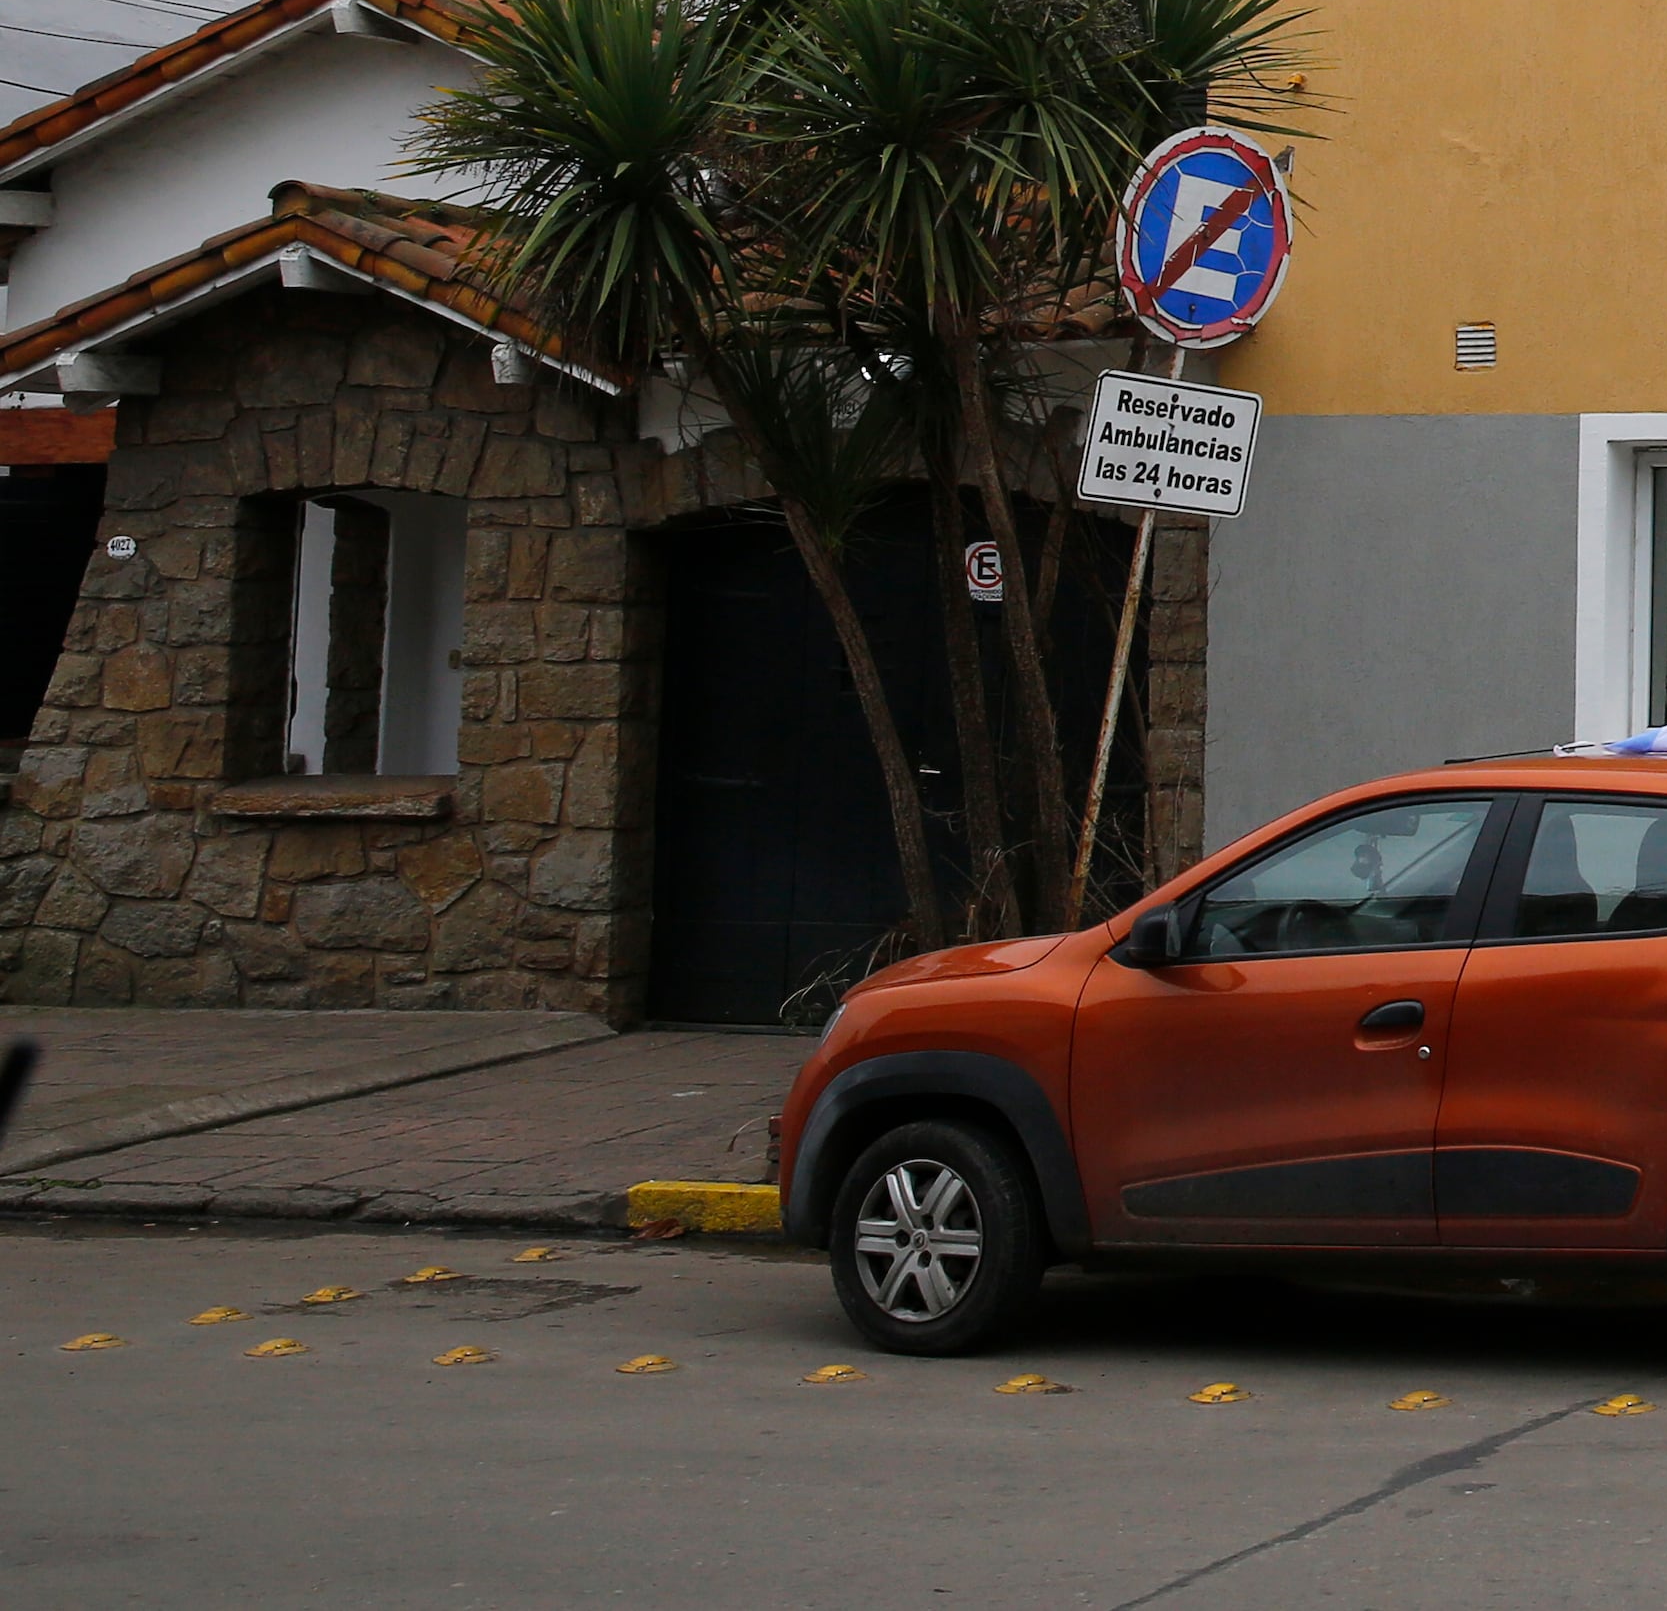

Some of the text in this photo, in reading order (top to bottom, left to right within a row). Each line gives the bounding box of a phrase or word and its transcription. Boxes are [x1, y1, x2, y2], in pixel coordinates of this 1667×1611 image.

[1117, 390, 1235, 428] Reservado
[1099, 422, 1242, 462] Ambulancias
[1095, 456, 1232, 496] las 24 horas
[111, 539, 131, 551] 4027
